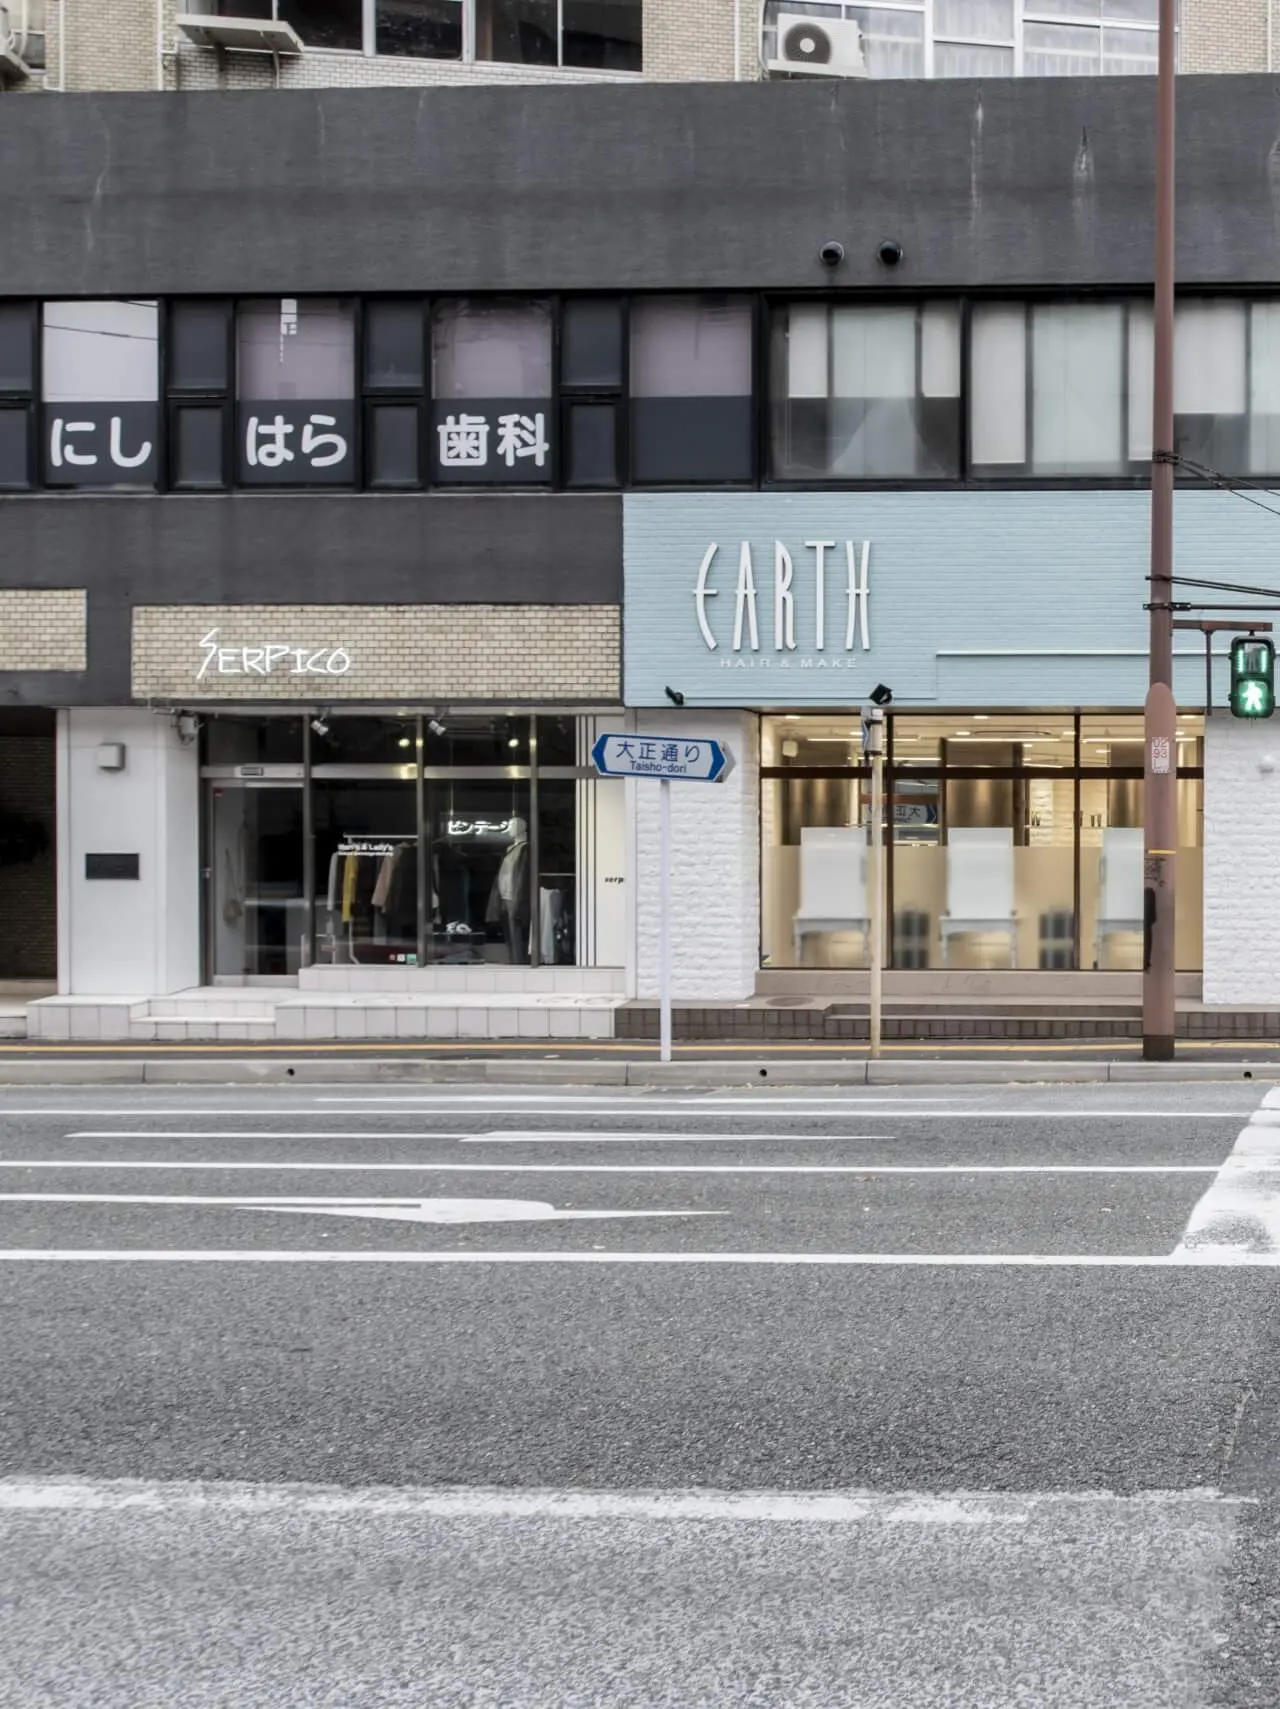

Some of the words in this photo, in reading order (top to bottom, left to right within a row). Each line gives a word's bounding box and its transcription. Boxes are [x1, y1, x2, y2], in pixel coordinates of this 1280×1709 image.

[51, 418, 151, 466] にし
[246, 414, 347, 466] はら
[437, 413, 549, 466] 歯科
[693, 540, 871, 651] EARTH
[197, 628, 350, 679] SERPICO
[720, 658, 770, 668] HAIR
[780, 658, 792, 668] &
[800, 658, 857, 668] MAKE
[616, 740, 700, 763] 大正通り
[630, 760, 687, 773] Taisho-dori
